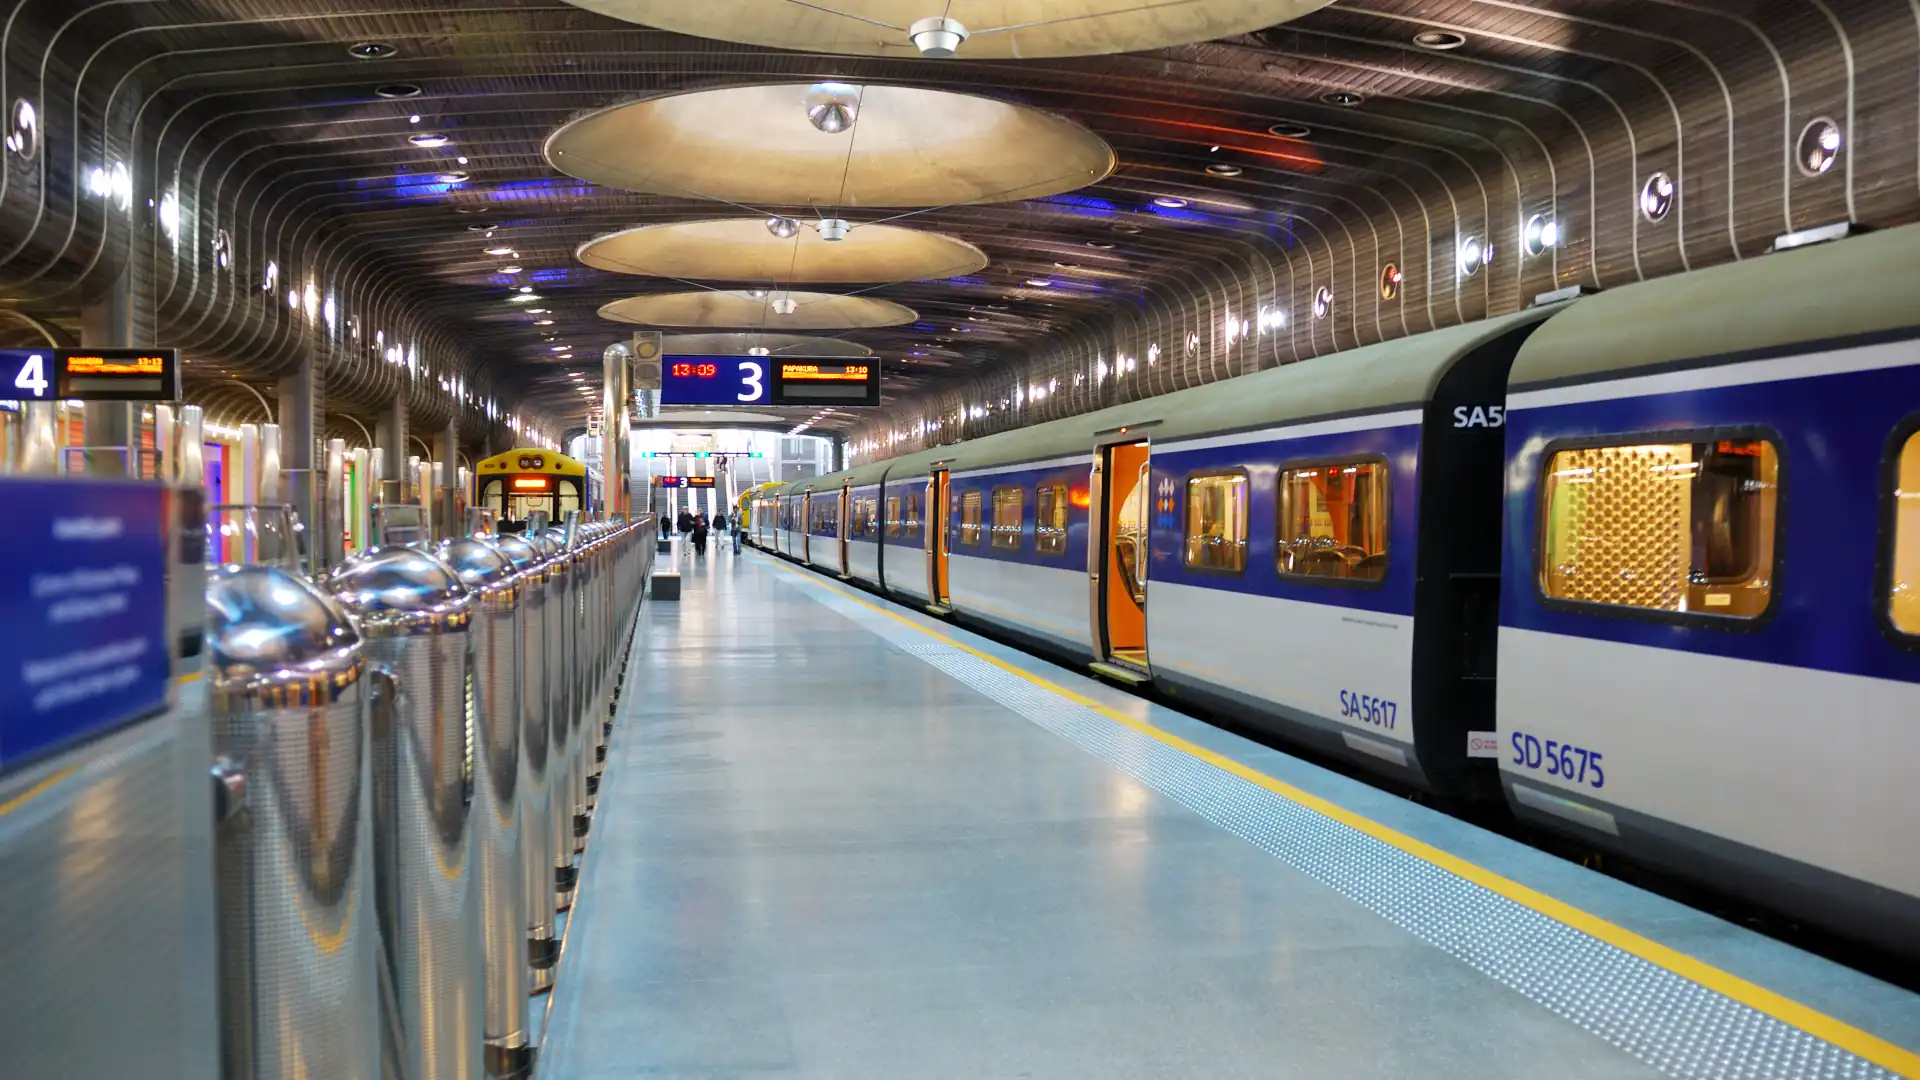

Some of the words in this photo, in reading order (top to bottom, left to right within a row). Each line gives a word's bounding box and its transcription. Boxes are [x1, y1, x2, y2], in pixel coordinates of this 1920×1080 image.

[15, 354, 49, 397] 4
[672, 363, 717, 377] 13:09
[782, 364, 818, 373] PAPAKURA
[845, 365, 868, 374] 13:10
[737, 361, 763, 401] 3
[1453, 405, 1506, 428] SA5
[679, 476, 688, 488] 3
